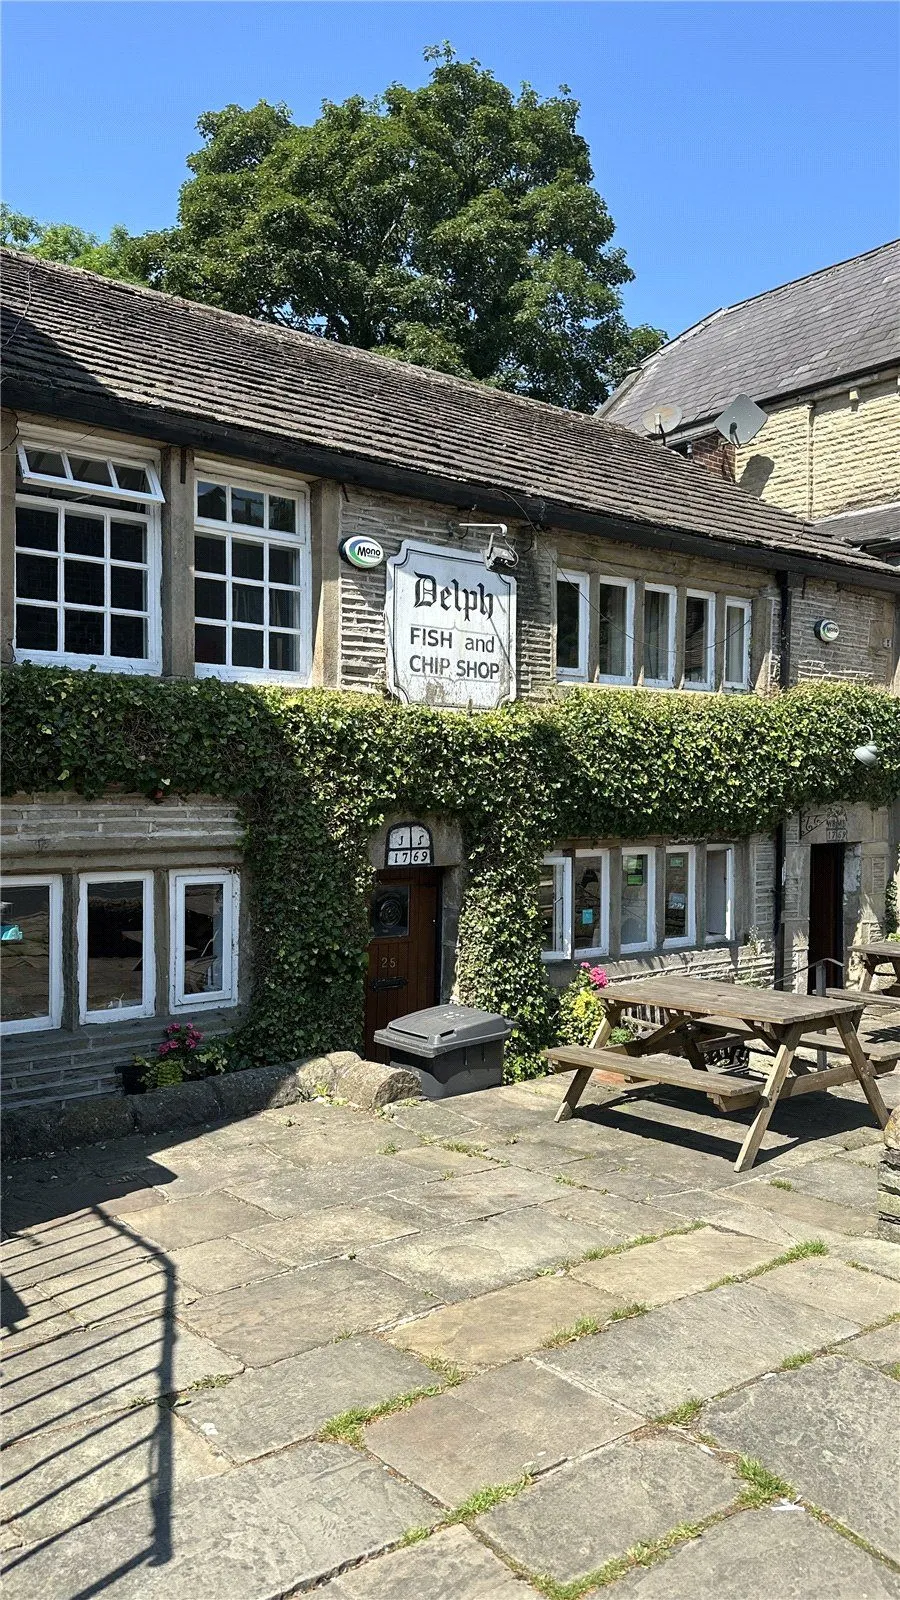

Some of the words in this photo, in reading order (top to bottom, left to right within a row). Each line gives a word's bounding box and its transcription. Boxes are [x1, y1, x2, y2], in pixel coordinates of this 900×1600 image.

[357, 545, 381, 557] Mono
[413, 571, 493, 621] Delph
[410, 627, 453, 649] FISH
[465, 636, 495, 652] and
[409, 654, 450, 674] CHIP
[456, 659, 500, 680] SHOP
[381, 957, 396, 969] 25
